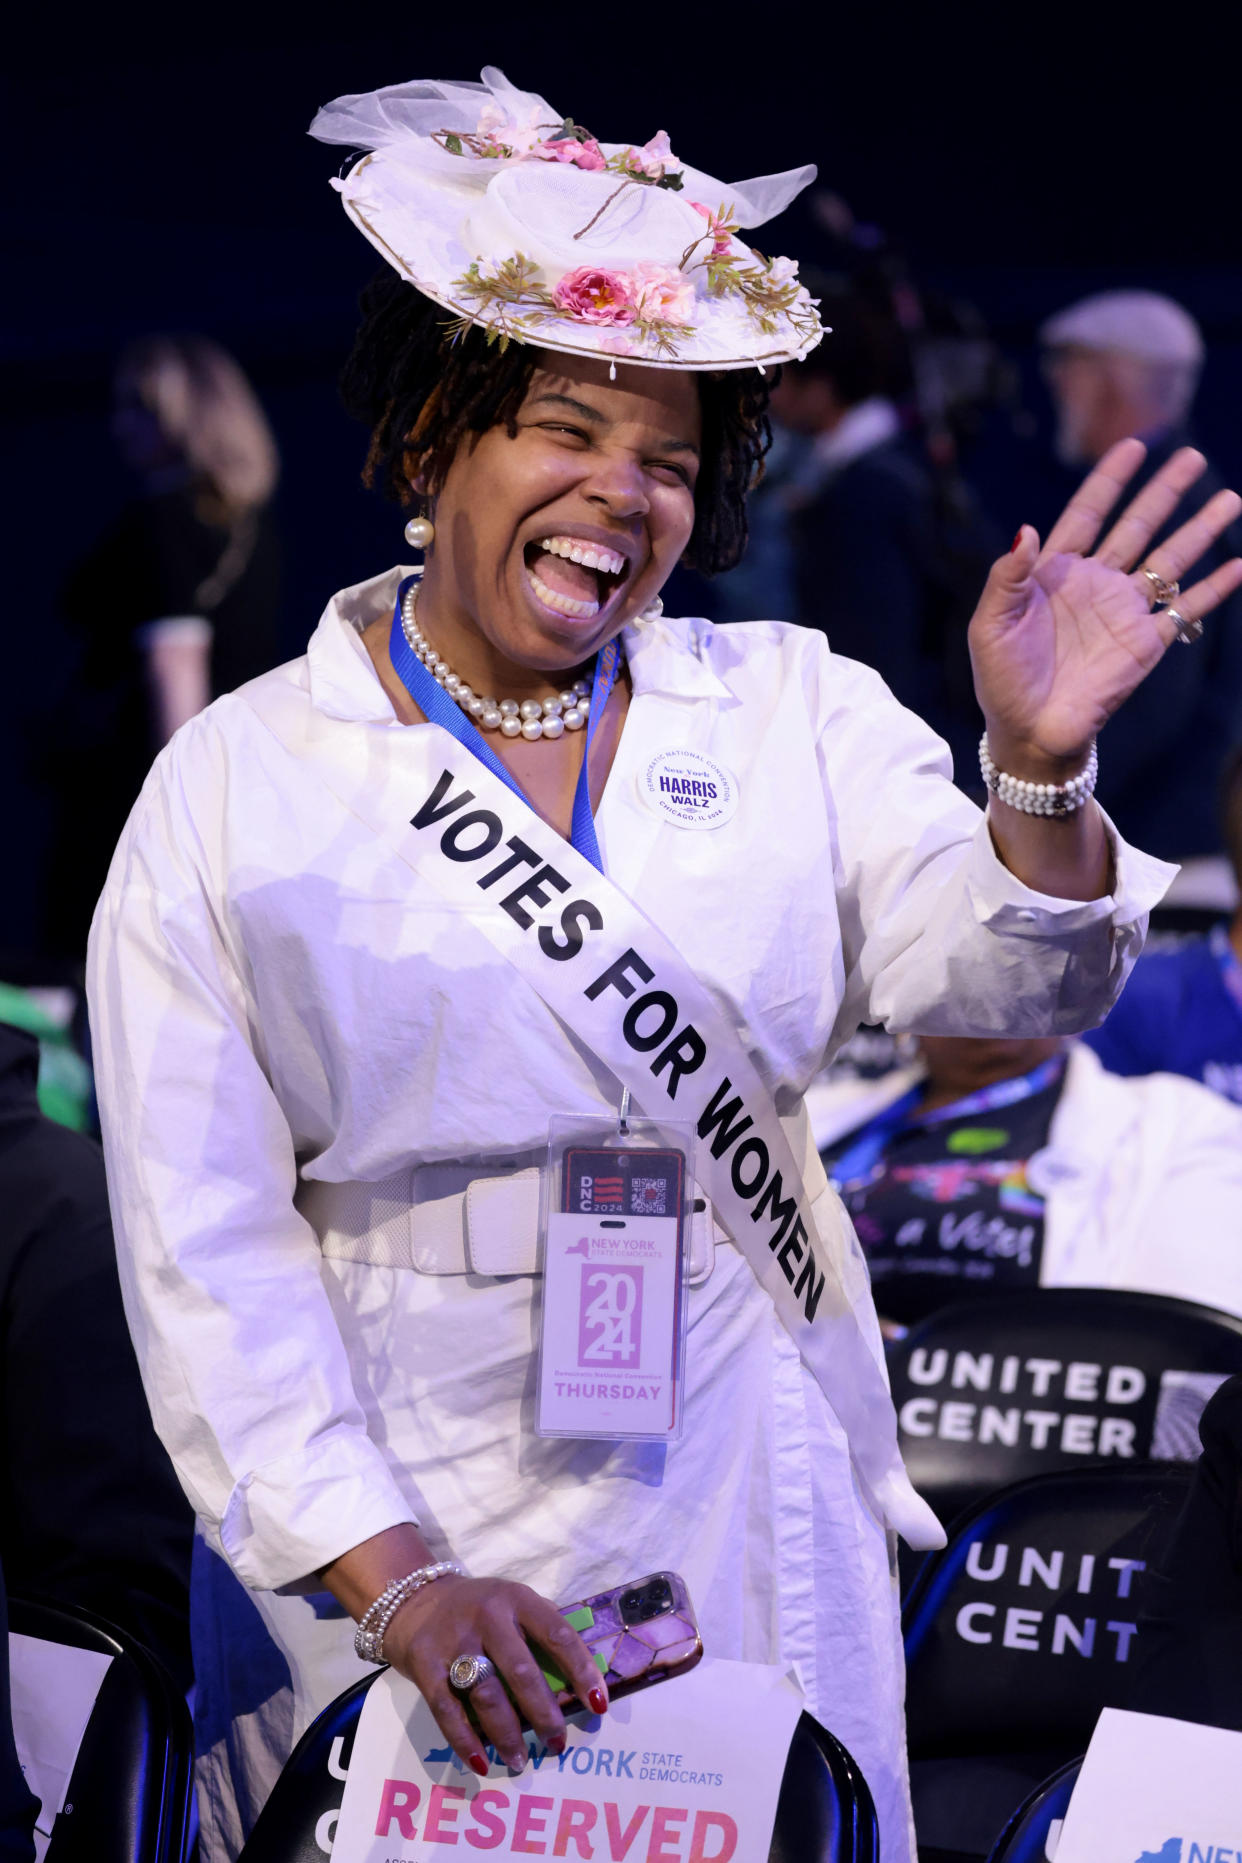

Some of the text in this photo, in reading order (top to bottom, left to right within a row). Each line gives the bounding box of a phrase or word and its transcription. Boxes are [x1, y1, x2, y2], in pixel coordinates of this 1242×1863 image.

[646, 750, 730, 803] DEMOCRATIC NATIONAL CONVENTION
[659, 776, 717, 799] HARRIS
[664, 766, 710, 778] New York
[659, 801, 697, 822] CHICAGO,
[671, 795, 710, 808] WALZ
[410, 769, 825, 1324] VOTES FOR WOMEN
[580, 1176, 593, 1212] DNC
[592, 1238, 655, 1250] NEW YORK
[616, 1250, 662, 1258] DEMOCRATS
[585, 1272, 637, 1317] 20
[583, 1317, 636, 1361] 24
[554, 1383, 662, 1400] THURSDAY
[907, 1348, 1146, 1405] UNITED
[900, 1397, 1137, 1458] CENTER
[965, 1541, 1146, 1599] UNIT
[956, 1602, 1138, 1662] CENT
[557, 1745, 637, 1779] YORK
[639, 1767, 724, 1787] DEMOCRATS
[641, 1752, 683, 1767] STATE
[374, 1778, 738, 1863] RESERVED
